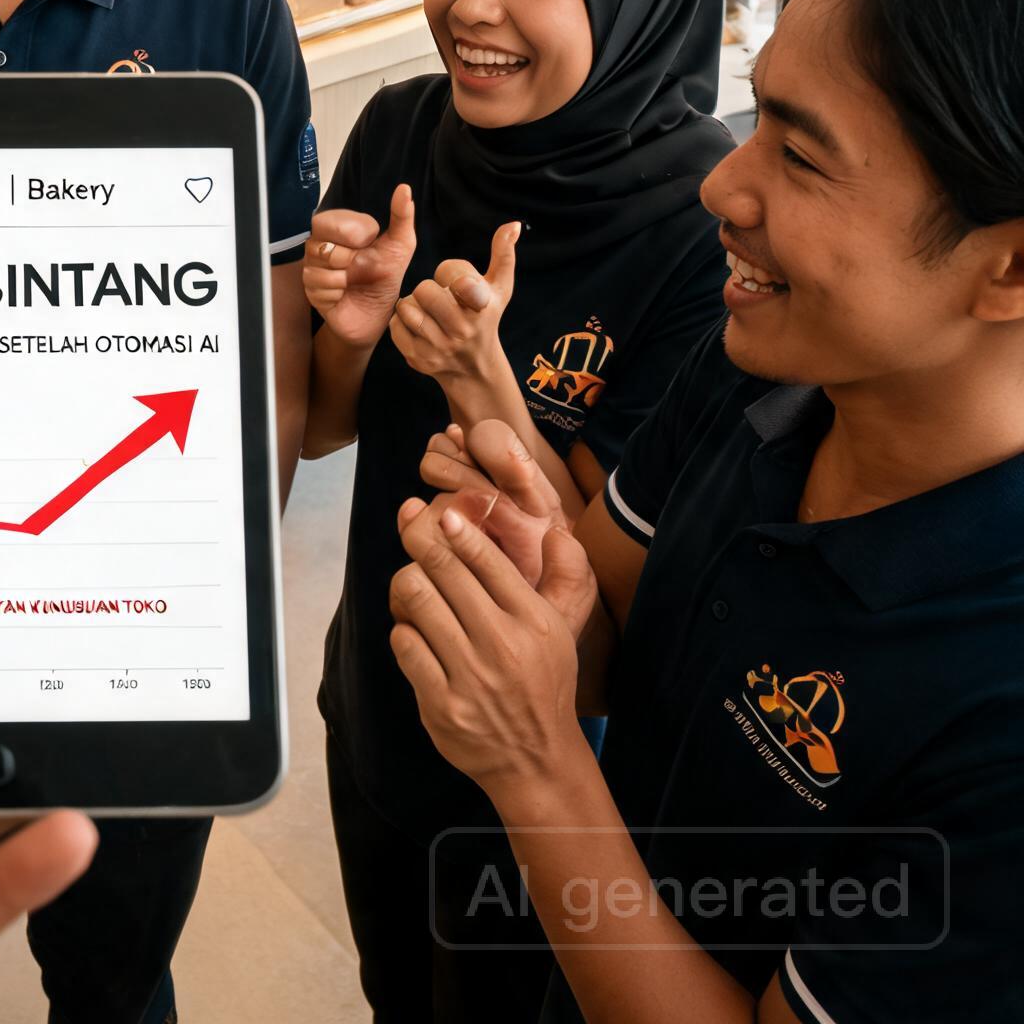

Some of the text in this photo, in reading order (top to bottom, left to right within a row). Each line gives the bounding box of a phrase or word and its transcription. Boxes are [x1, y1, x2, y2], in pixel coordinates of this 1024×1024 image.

[28, 177, 116, 205] Bakery
[95, 335, 193, 353] OTOMASI
[199, 335, 219, 353] AI
[122, 599, 168, 614] TOKO
